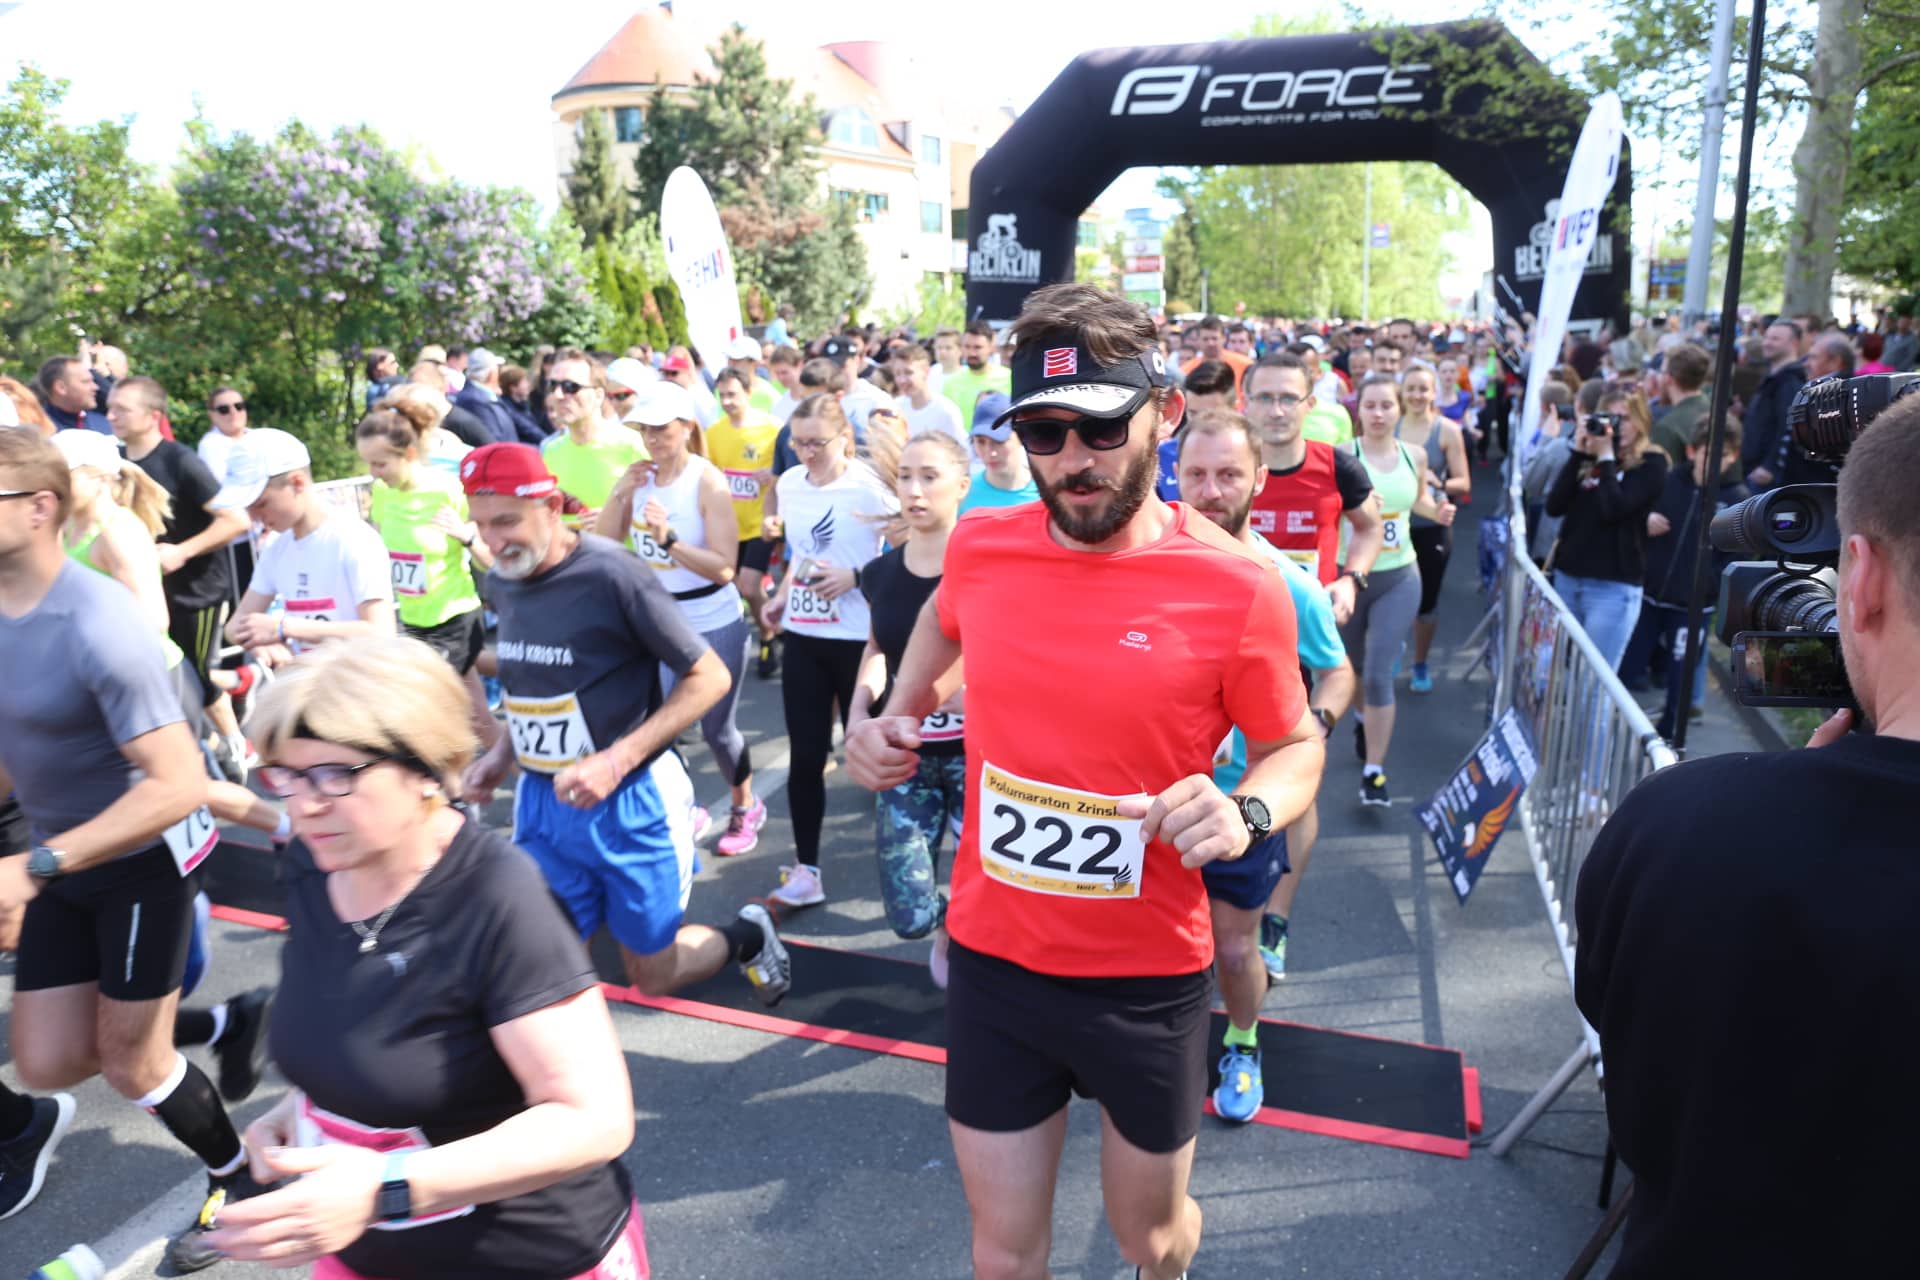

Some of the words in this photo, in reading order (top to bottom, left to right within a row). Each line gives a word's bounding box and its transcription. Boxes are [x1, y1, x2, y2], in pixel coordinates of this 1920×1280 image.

[1200, 63, 1432, 113] FORCE
[1309, 111, 1344, 122] FOR
[525, 644, 574, 666] KRISTA
[989, 775, 1070, 811] Polumaraton
[990, 803, 1122, 876] 222
